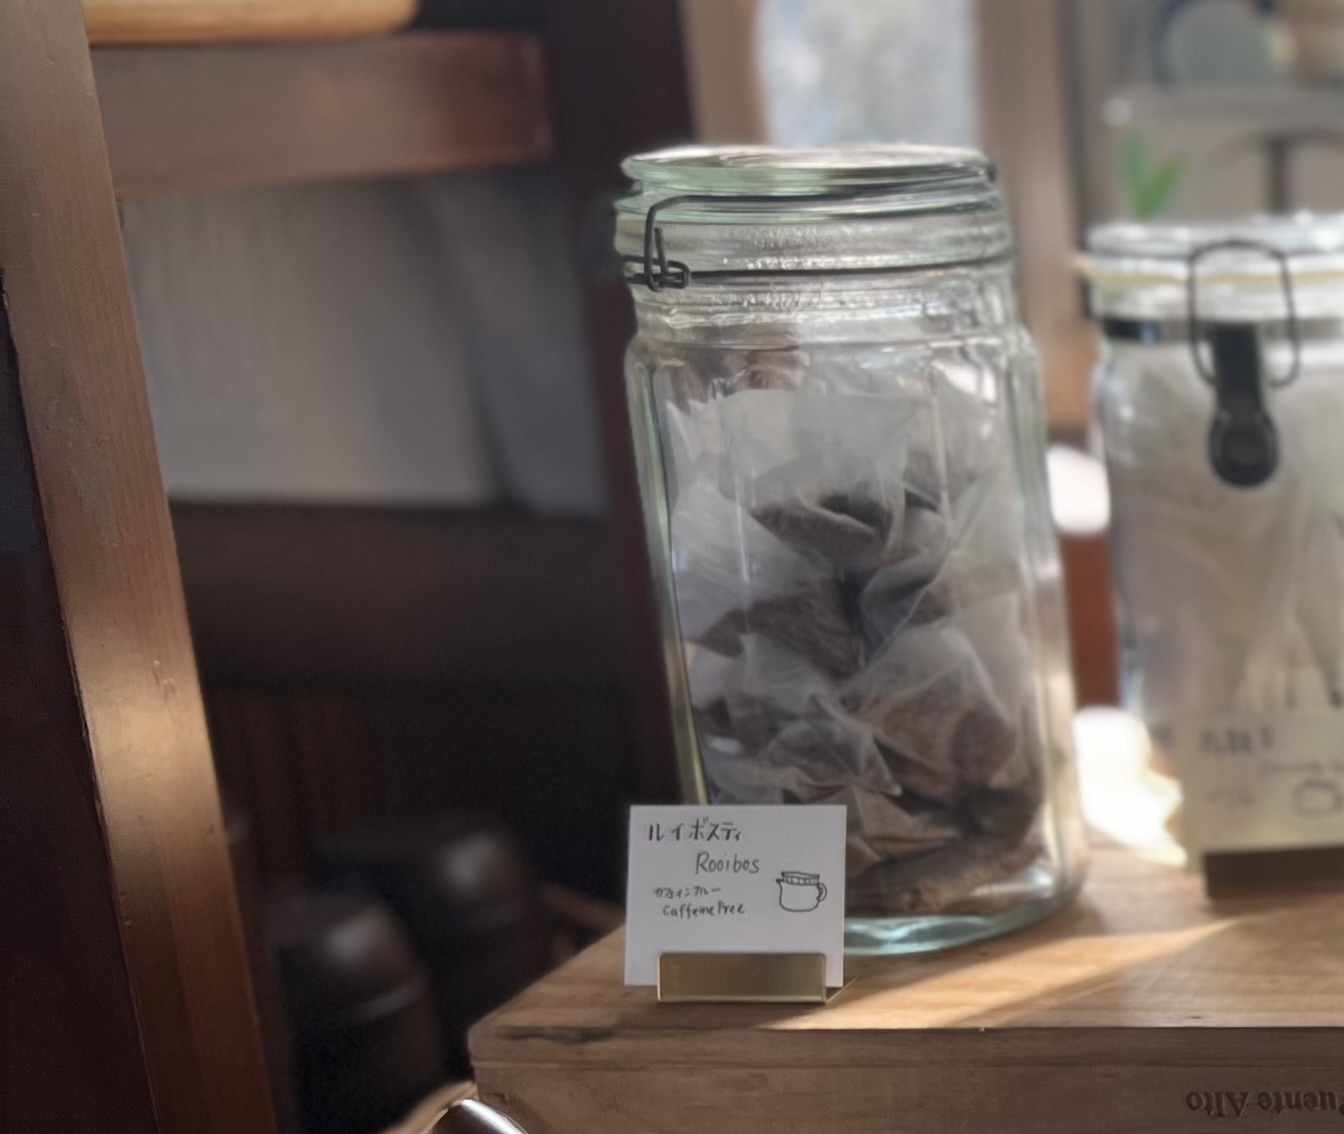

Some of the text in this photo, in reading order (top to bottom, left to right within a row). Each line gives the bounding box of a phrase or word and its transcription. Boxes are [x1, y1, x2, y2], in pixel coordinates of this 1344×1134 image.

[648, 817, 742, 842] ルイボスティ
[695, 851, 761, 875] Rooibos
[1186, 1090, 1250, 1117] Alto
